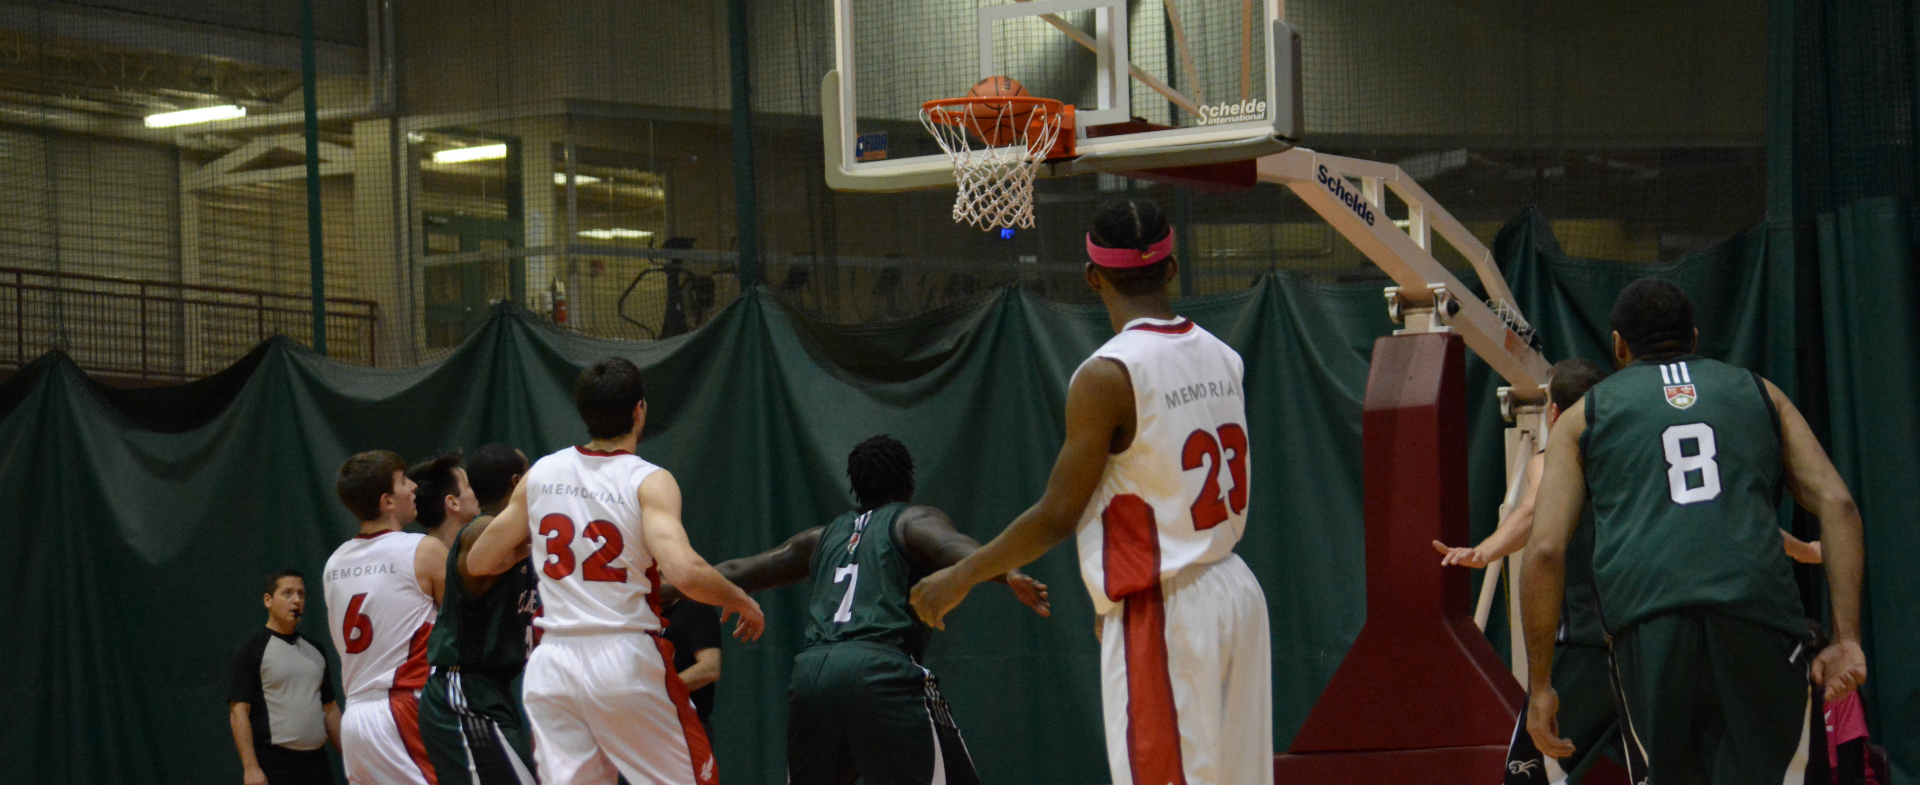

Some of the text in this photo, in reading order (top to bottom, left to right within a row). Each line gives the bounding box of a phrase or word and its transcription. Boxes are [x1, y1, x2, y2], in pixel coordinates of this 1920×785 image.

[1197, 98, 1267, 126] Schelde
[1208, 112, 1265, 125] international
[1317, 164, 1375, 227] Schelde
[1165, 380, 1239, 410] MEMORIA
[1181, 422, 1248, 532] 23
[1661, 422, 1722, 505] 8
[538, 512, 628, 584] 32
[342, 592, 374, 655] 6
[833, 563, 859, 623] 7
